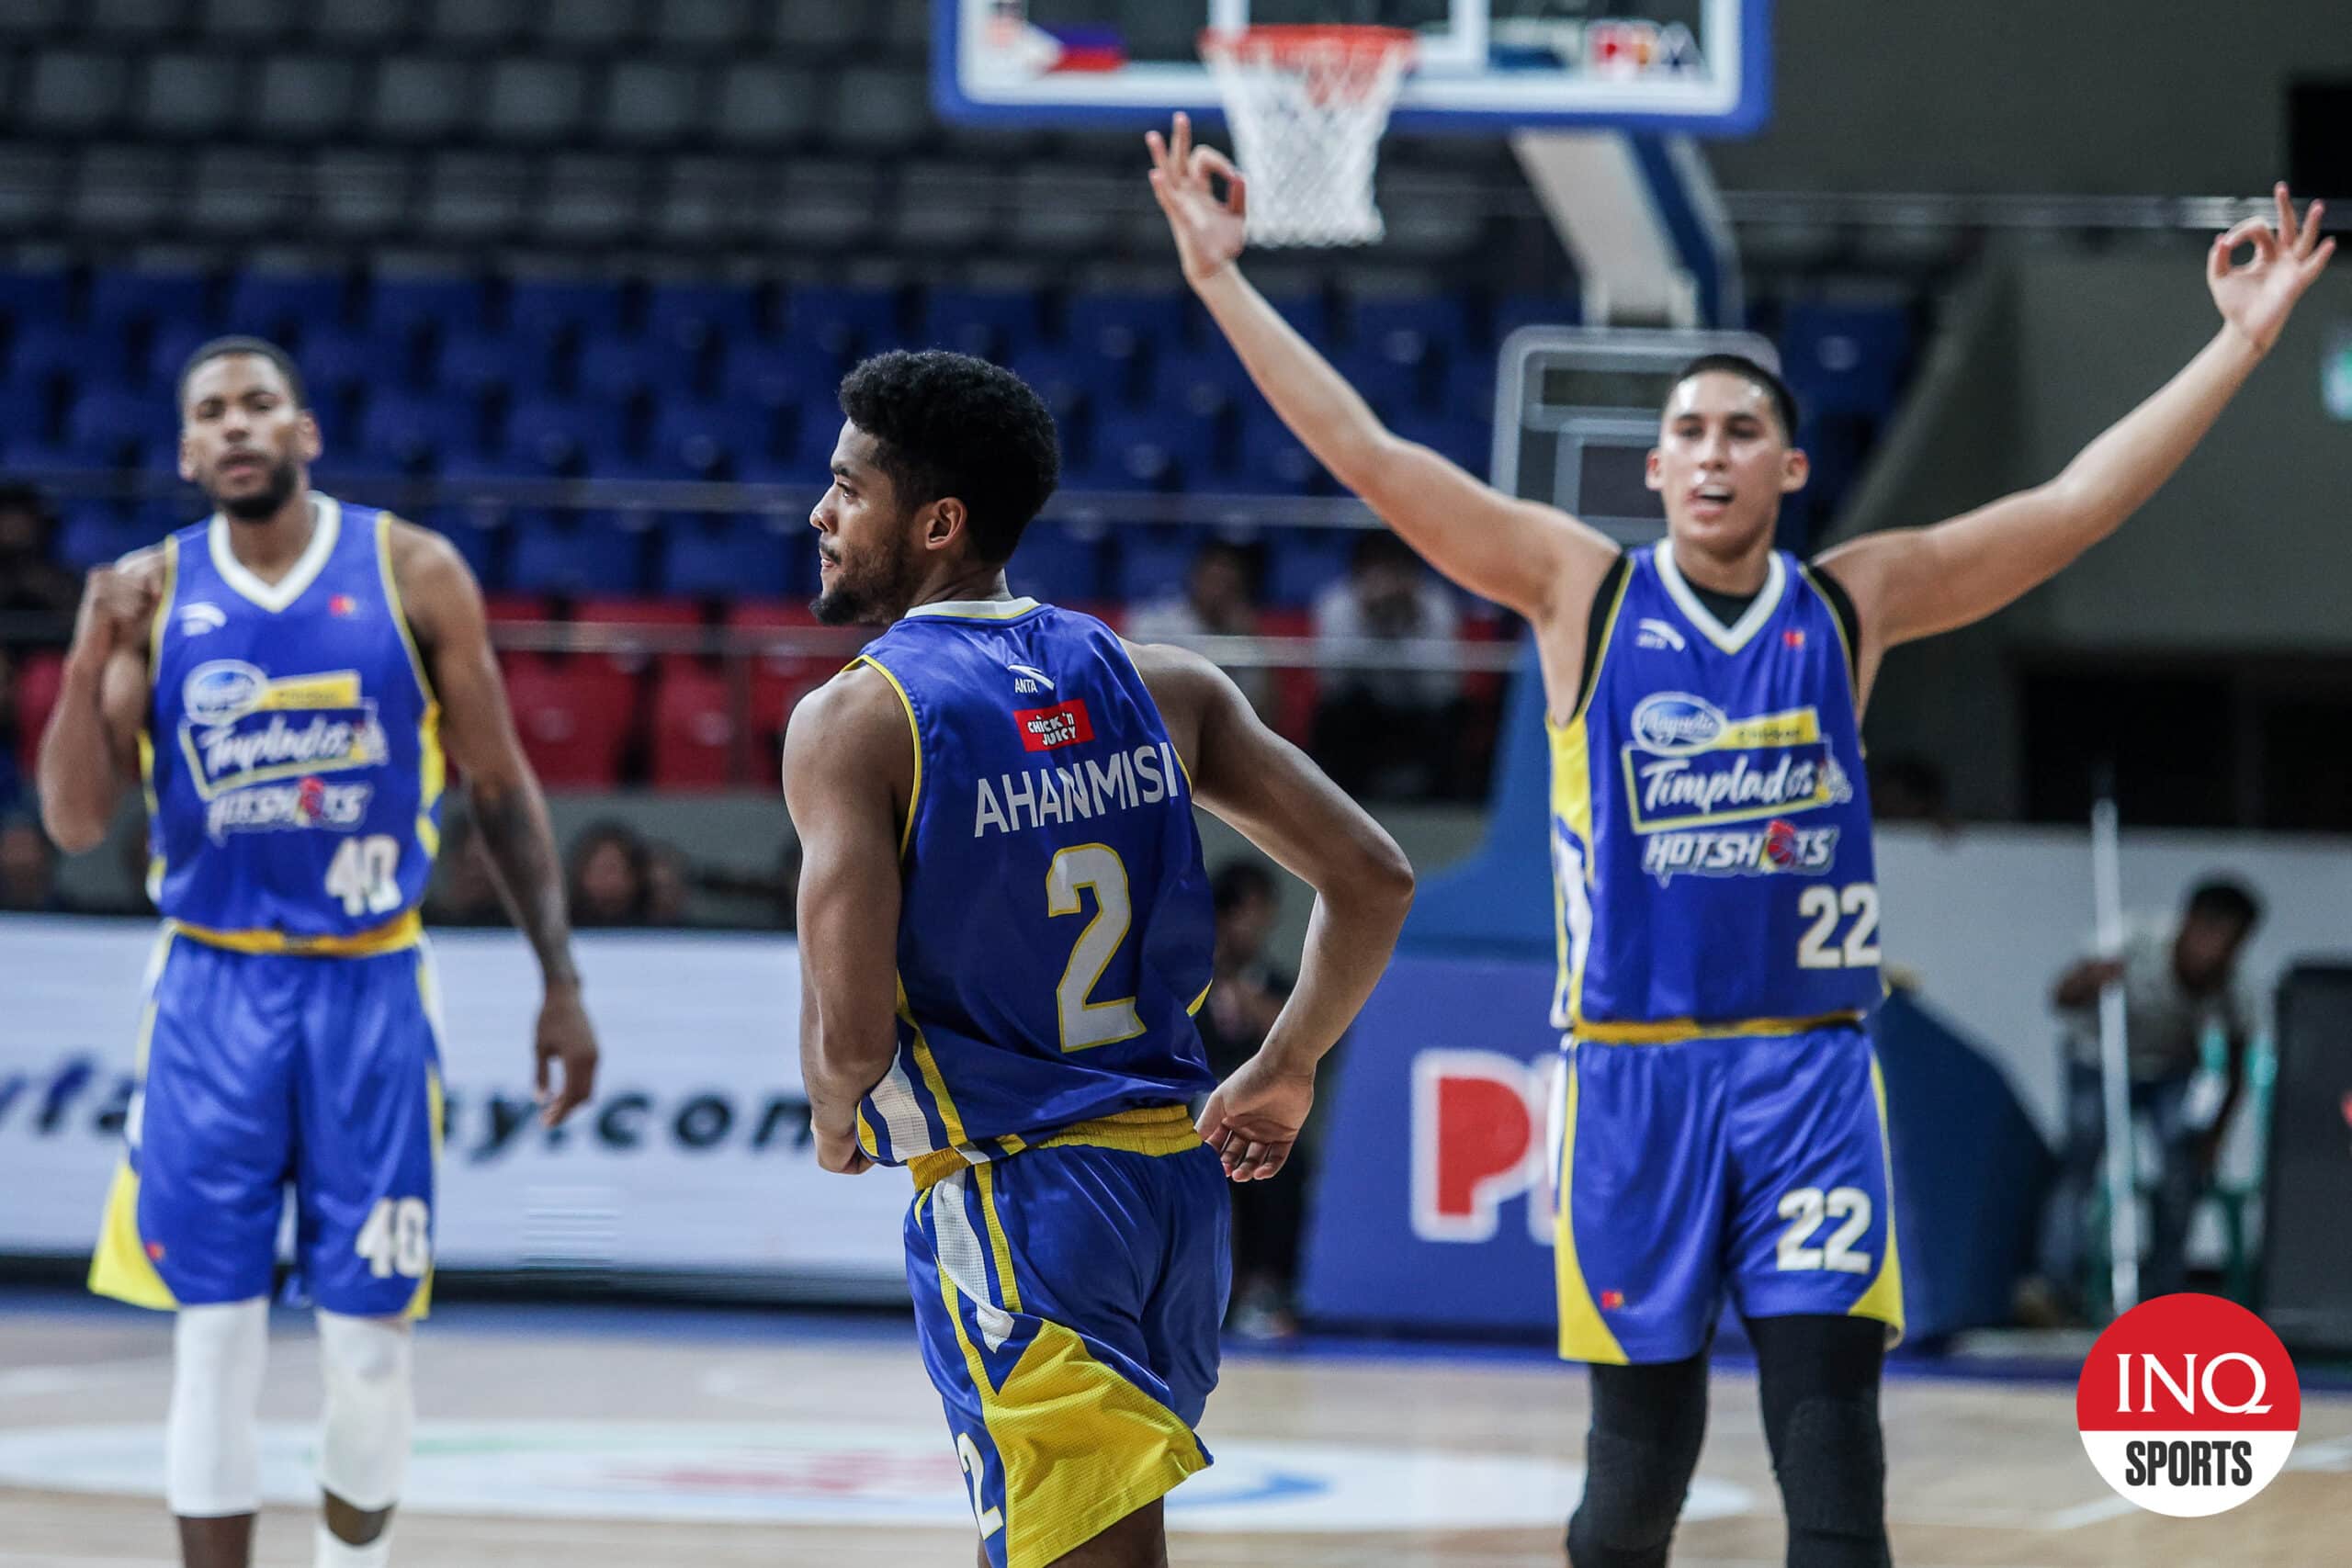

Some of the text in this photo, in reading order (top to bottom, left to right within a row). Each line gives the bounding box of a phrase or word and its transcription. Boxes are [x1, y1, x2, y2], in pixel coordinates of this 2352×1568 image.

[1014, 678, 1038, 694] ANTA
[974, 741, 1179, 838] AHANMISI
[324, 834, 402, 917] 40
[1046, 842, 1148, 1053] 2
[1797, 882, 1882, 969] 22
[356, 1196, 430, 1279] 40
[1777, 1186, 1871, 1275] 22
[957, 1432, 1003, 1541] 2
